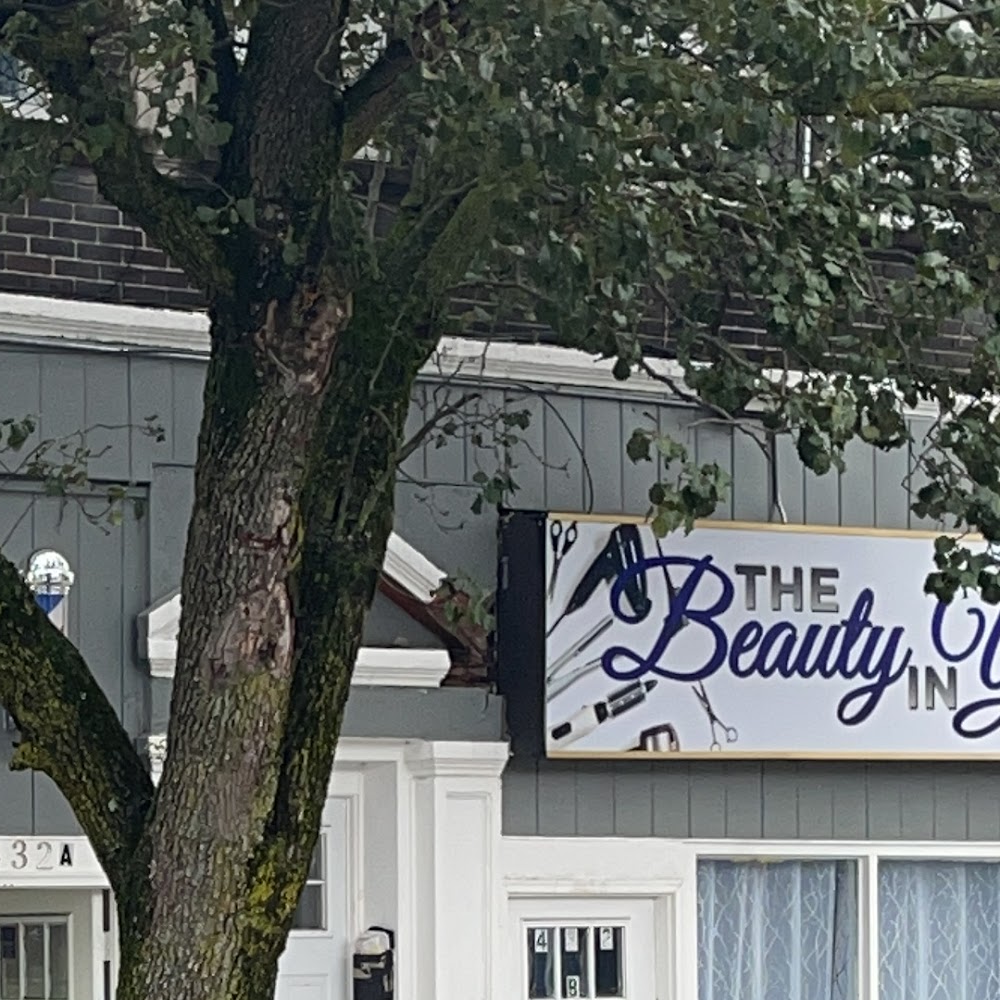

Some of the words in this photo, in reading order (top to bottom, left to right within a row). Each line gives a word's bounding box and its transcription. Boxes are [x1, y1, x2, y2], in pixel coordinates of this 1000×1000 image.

[734, 564, 839, 613] THE
[600, 554, 912, 726] Beauty
[907, 665, 957, 710] IN
